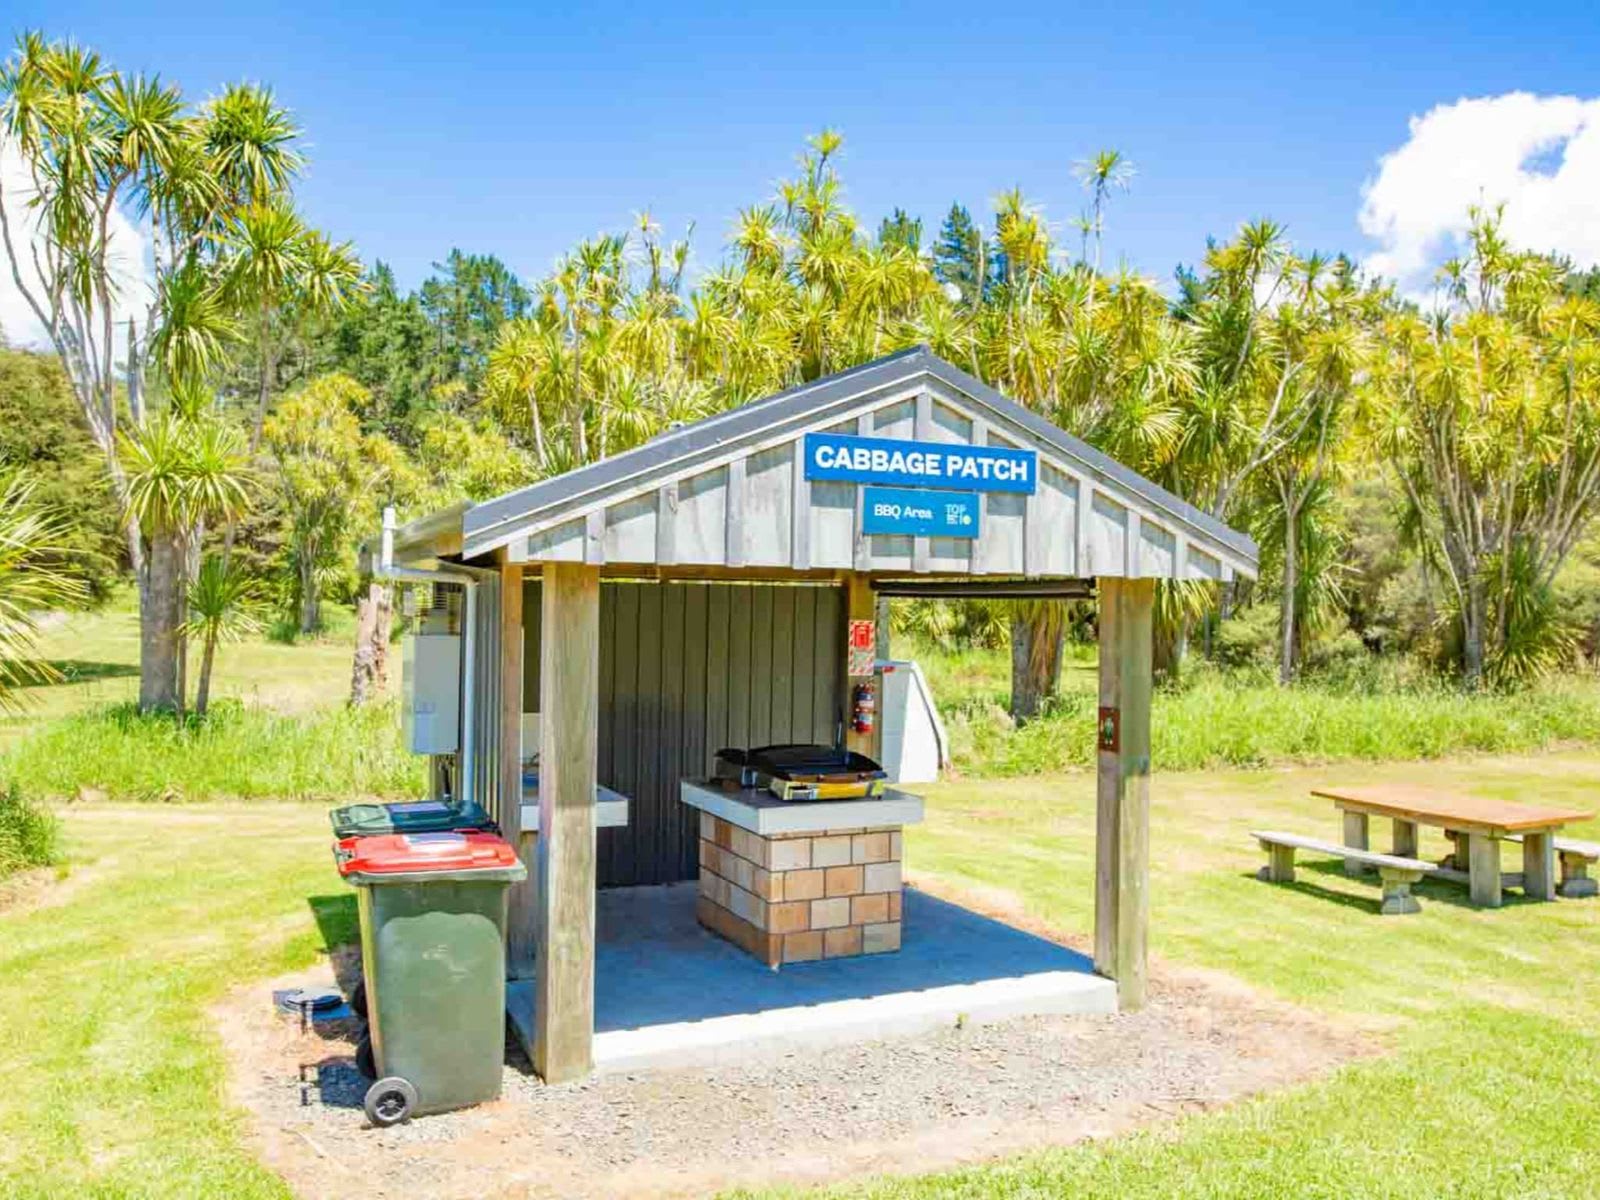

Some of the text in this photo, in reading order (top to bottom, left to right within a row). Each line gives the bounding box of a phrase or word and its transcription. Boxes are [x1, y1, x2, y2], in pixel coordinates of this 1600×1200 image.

[815, 446, 1028, 480] CABBAGE PATCH
[874, 504, 932, 519] BBQ Area
